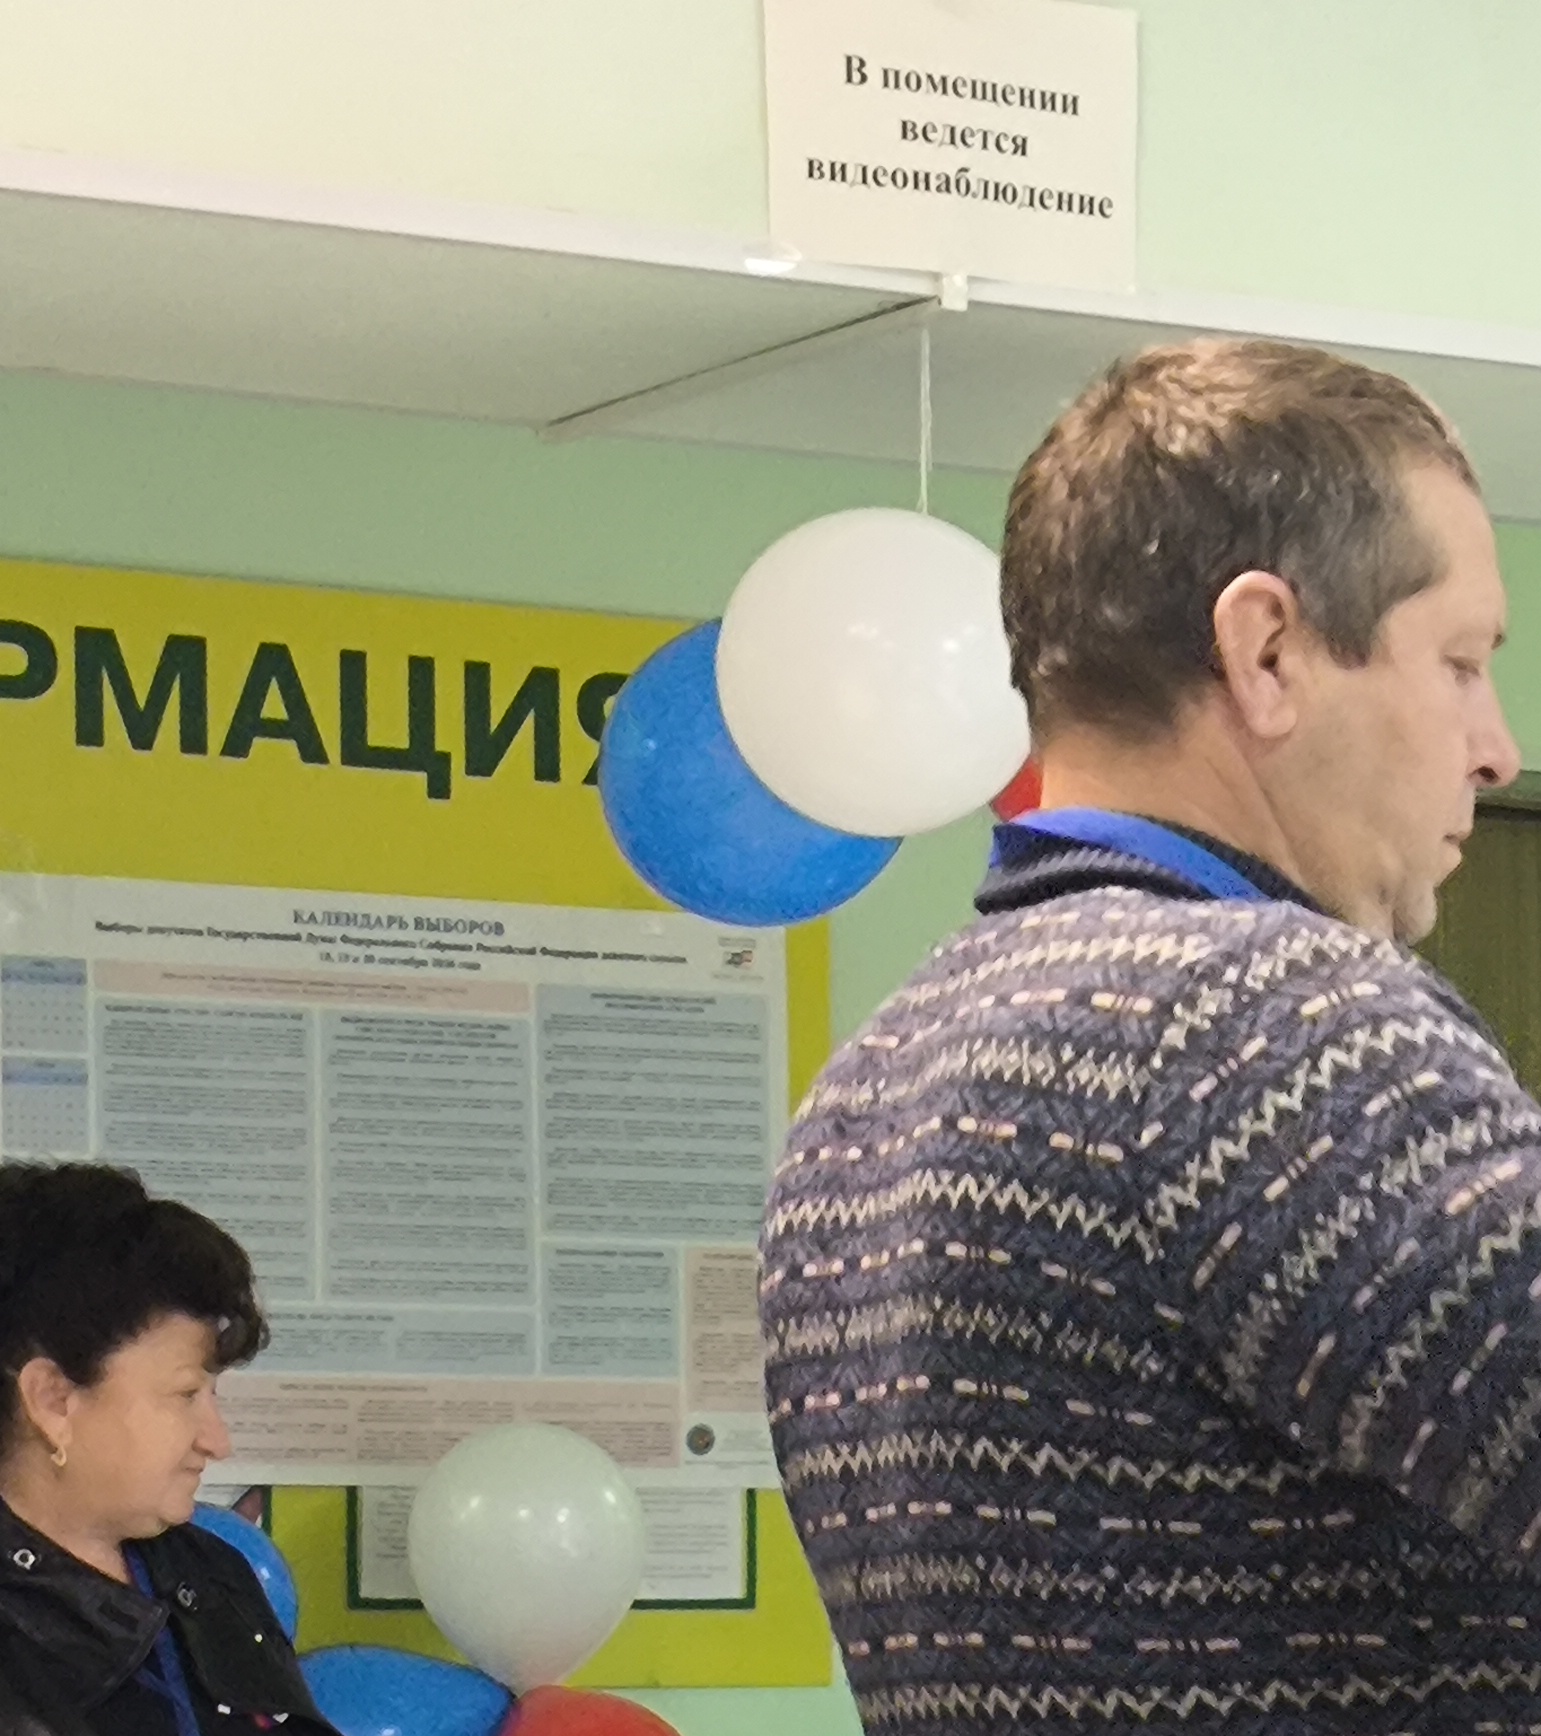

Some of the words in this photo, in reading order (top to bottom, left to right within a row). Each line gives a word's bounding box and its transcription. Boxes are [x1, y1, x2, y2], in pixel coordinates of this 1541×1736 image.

[844, 54, 869, 86] В
[881, 66, 1080, 116] помещении
[900, 118, 1029, 157] ведется
[806, 156, 1114, 219] видеонаблюдение
[292, 908, 410, 931] КАЛЕНДАРЬ
[413, 914, 505, 937] ВЫБОРОВ
